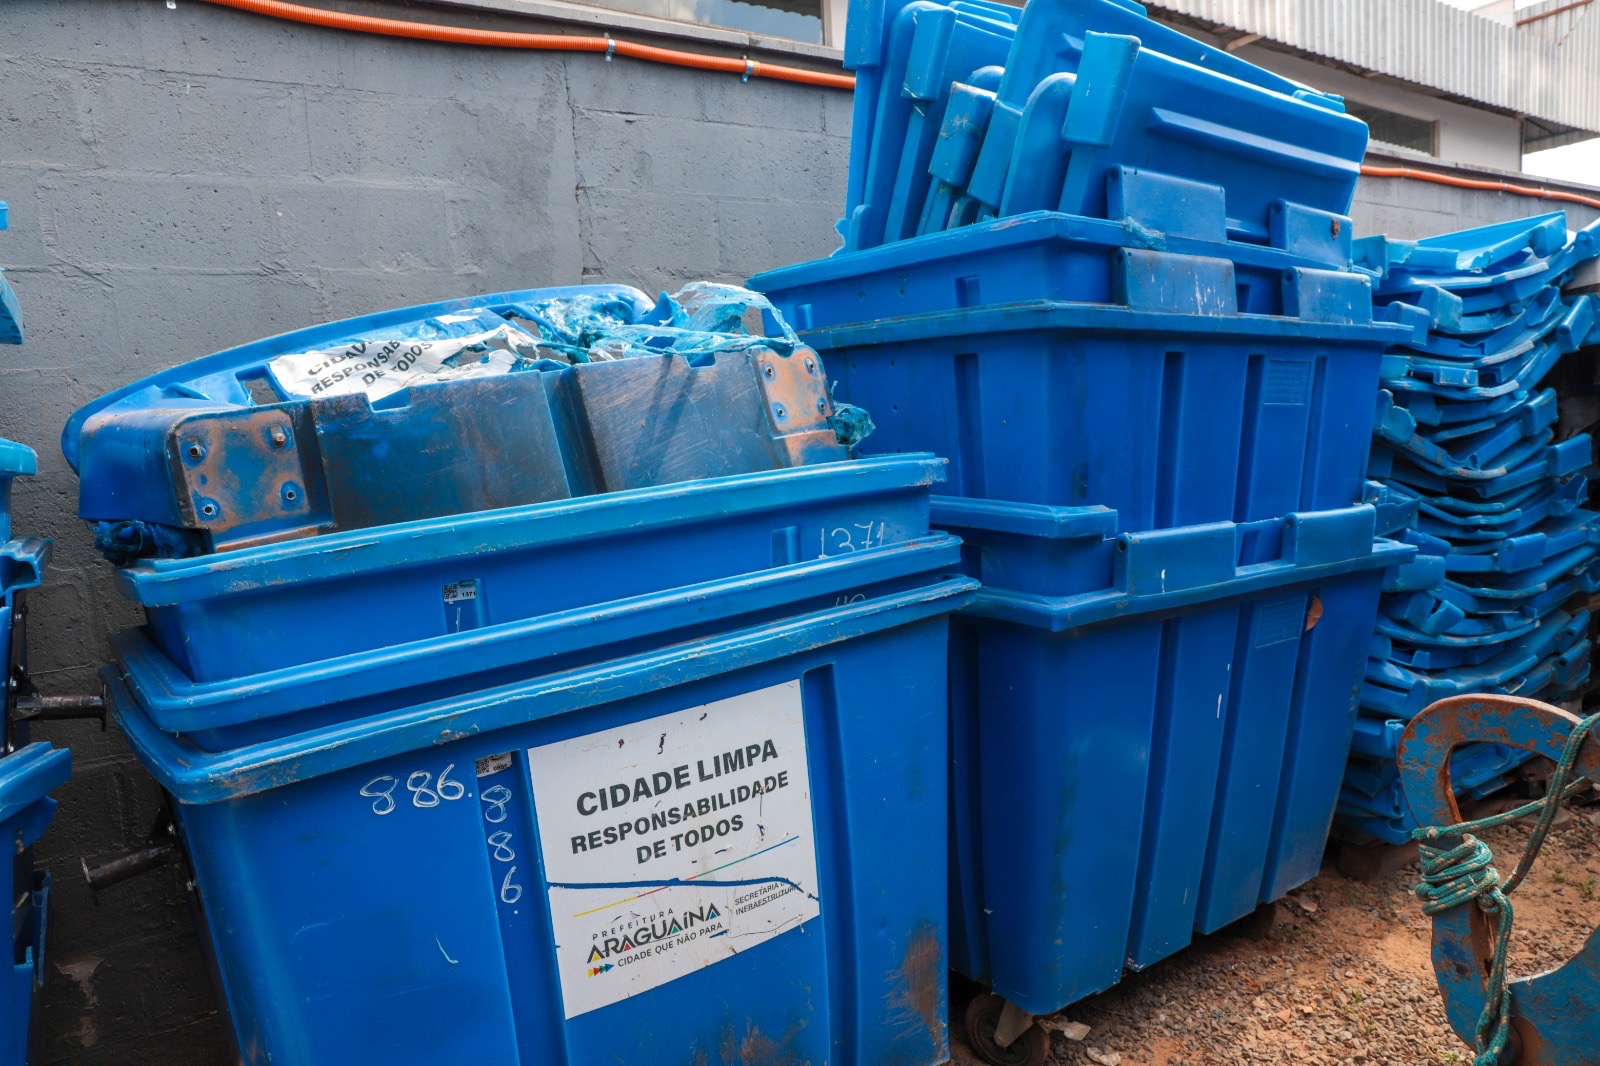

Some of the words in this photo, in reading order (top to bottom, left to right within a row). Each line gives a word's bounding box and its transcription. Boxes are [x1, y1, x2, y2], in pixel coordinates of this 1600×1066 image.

[308, 341, 372, 376] CIDA
[362, 369, 386, 386] DE
[818, 521, 885, 559] 1371
[576, 764, 691, 816] CIDADE
[697, 739, 779, 783] LIMPA
[570, 771, 789, 854] RESPONSABILIDADE
[636, 840, 667, 864] DE
[670, 814, 744, 851] TODOS
[735, 882, 779, 906] SECRETARIA
[735, 884, 797, 916] INFRAESTRUTUR
[592, 908, 674, 940] PREFEITURA
[617, 948, 652, 967] CIDADE
[655, 941, 674, 955] QUE
[677, 932, 697, 946] NÃO
[699, 922, 723, 937] PARA
